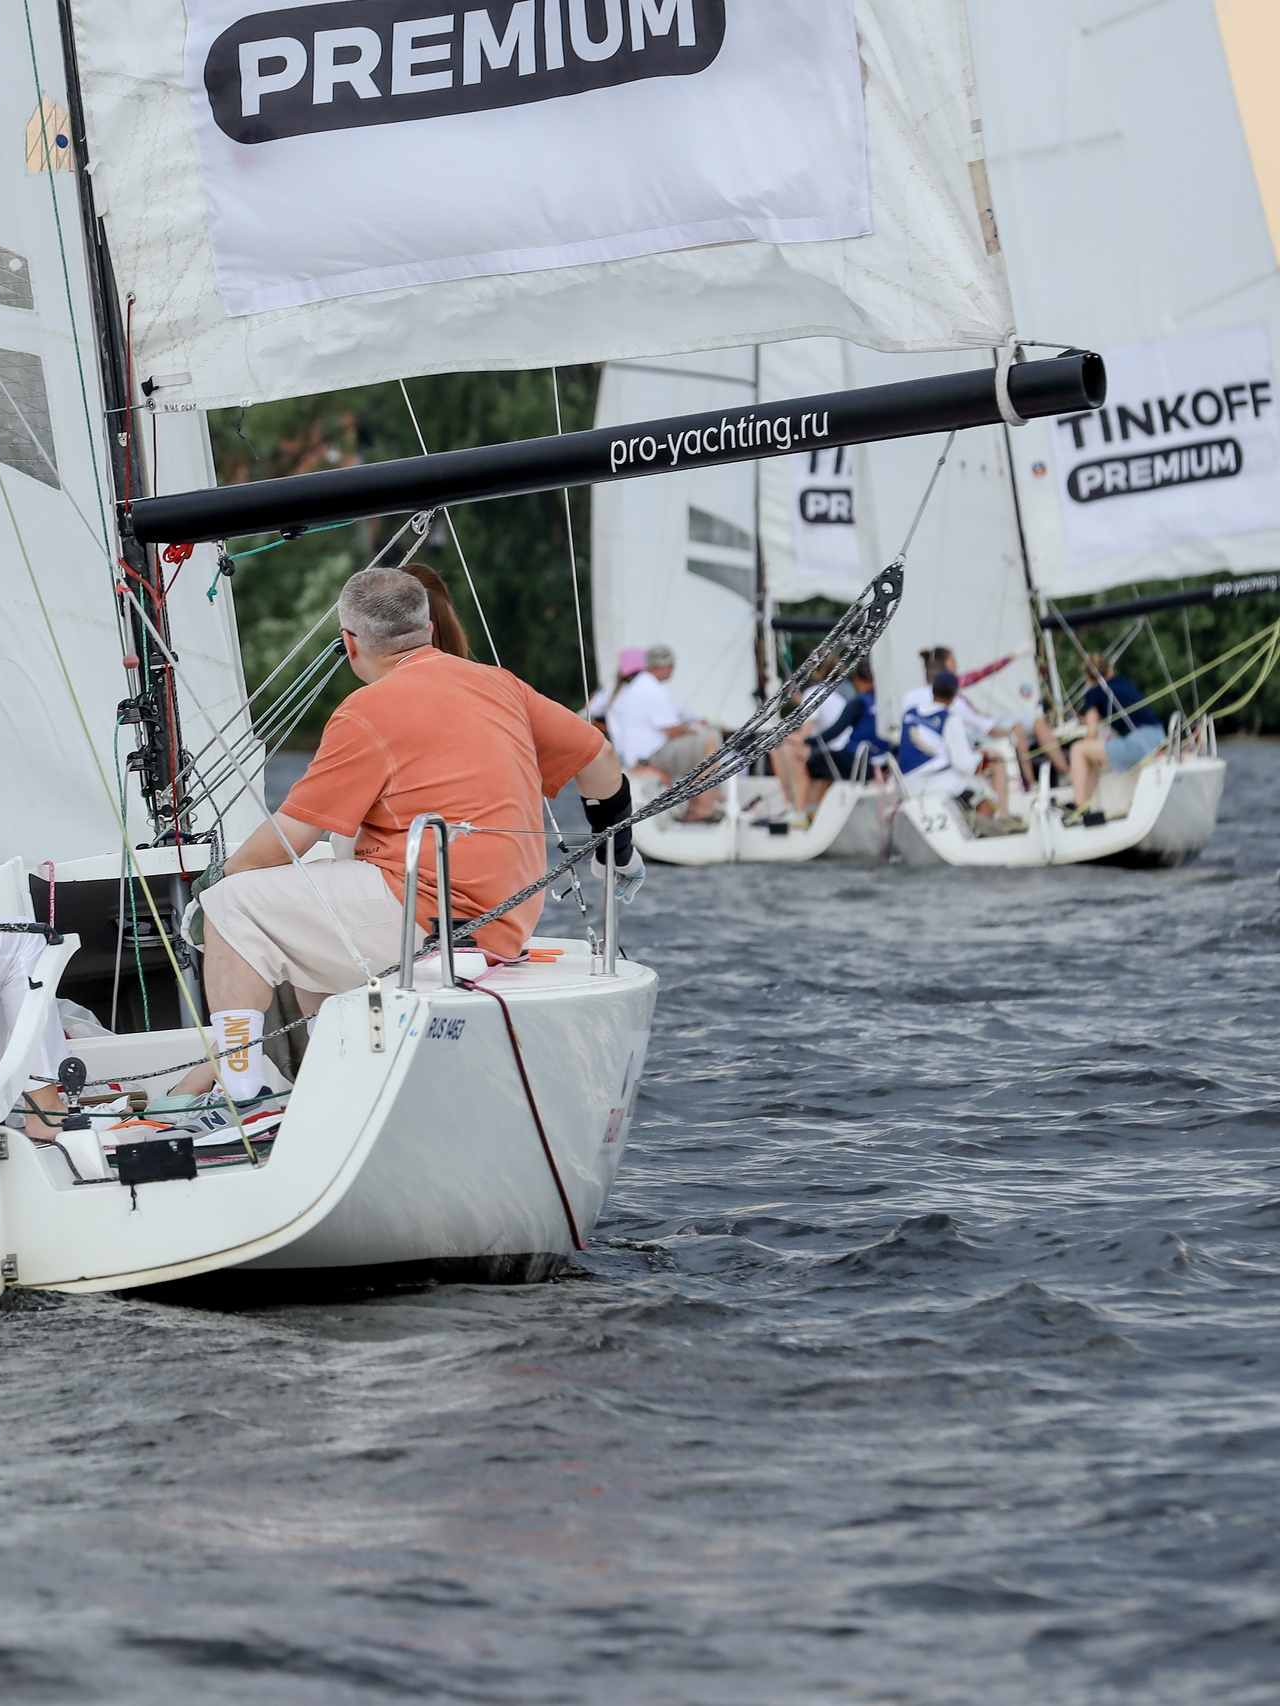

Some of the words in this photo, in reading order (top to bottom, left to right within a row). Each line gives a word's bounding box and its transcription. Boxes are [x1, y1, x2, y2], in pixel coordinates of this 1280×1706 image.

[238, 0, 698, 118] PREMIUM
[610, 411, 829, 474] pro-yachting.ru
[1057, 382, 1272, 449] TINKOFF
[1076, 441, 1237, 500] PREMIUM
[426, 1017, 448, 1039] RUS
